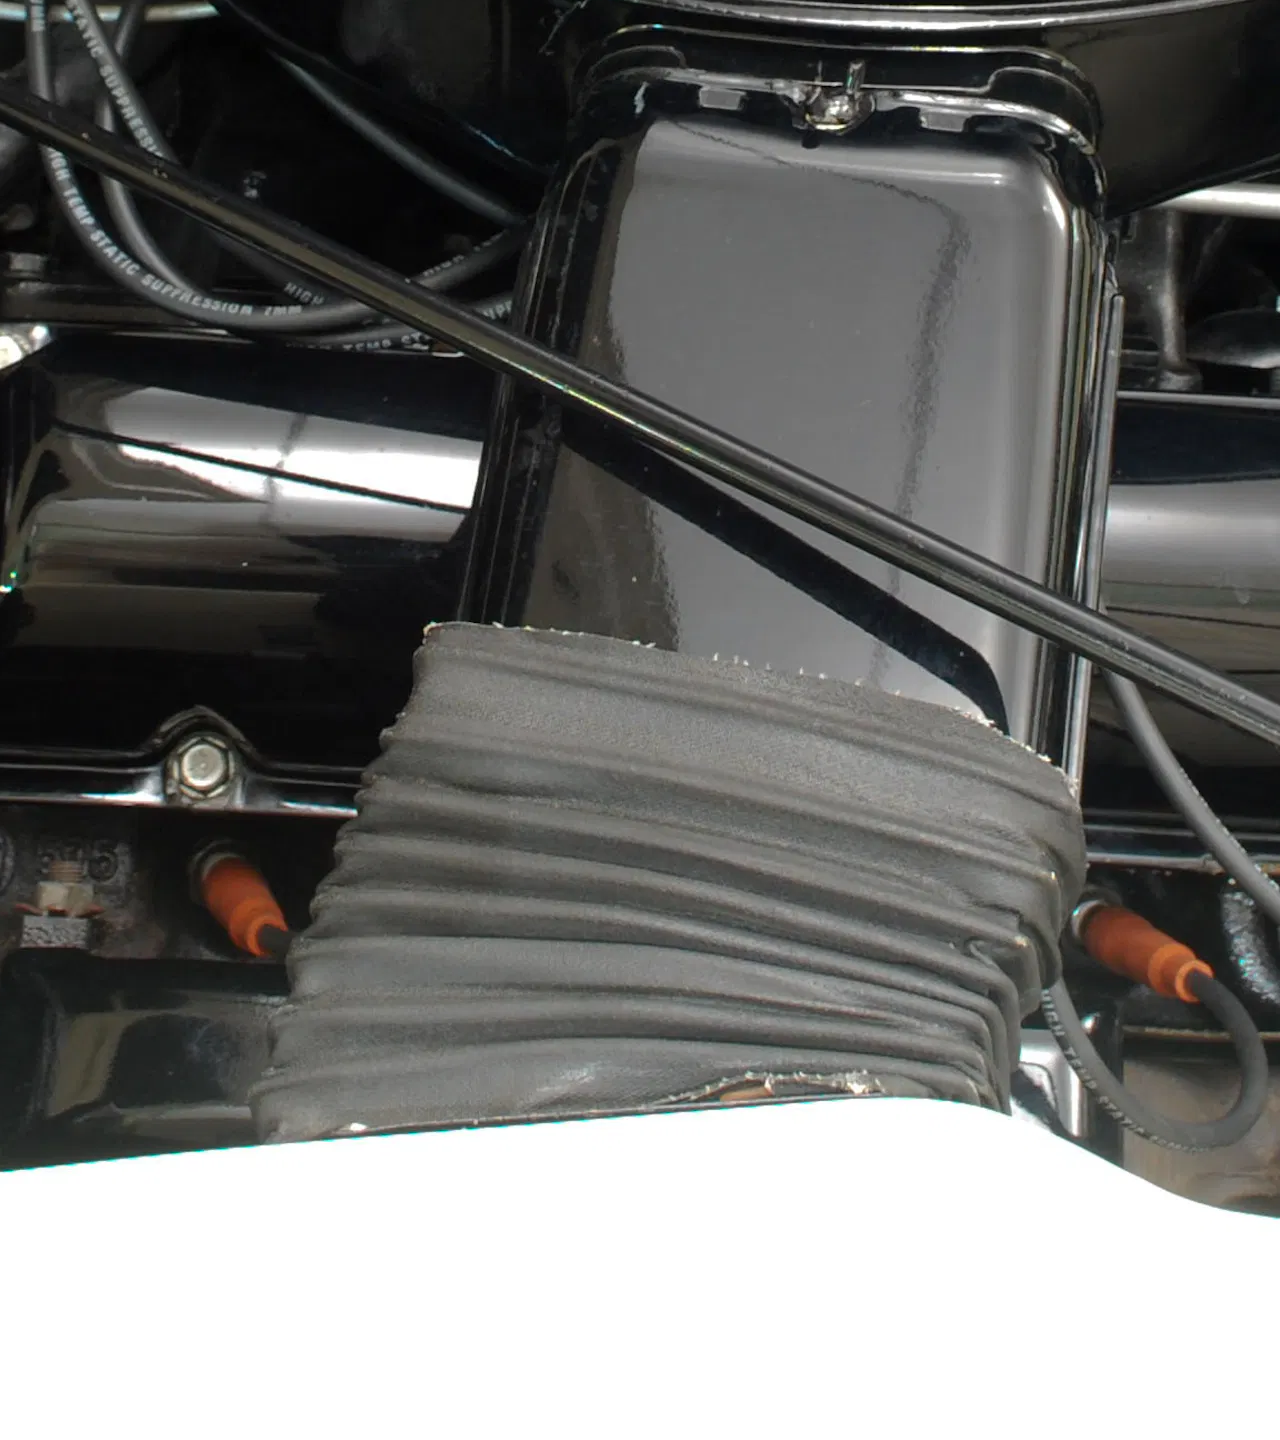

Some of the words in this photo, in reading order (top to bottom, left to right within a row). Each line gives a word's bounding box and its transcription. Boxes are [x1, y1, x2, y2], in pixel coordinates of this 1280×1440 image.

[63, 187, 96, 228] TEMP
[89, 230, 141, 277] STATIC
[140, 272, 253, 318] SUPPRESSION
[263, 304, 303, 318] 7MM
[284, 281, 325, 307] HIGH
[1042, 989, 1065, 1037] HIGH
[1063, 1046, 1098, 1090] TEMP
